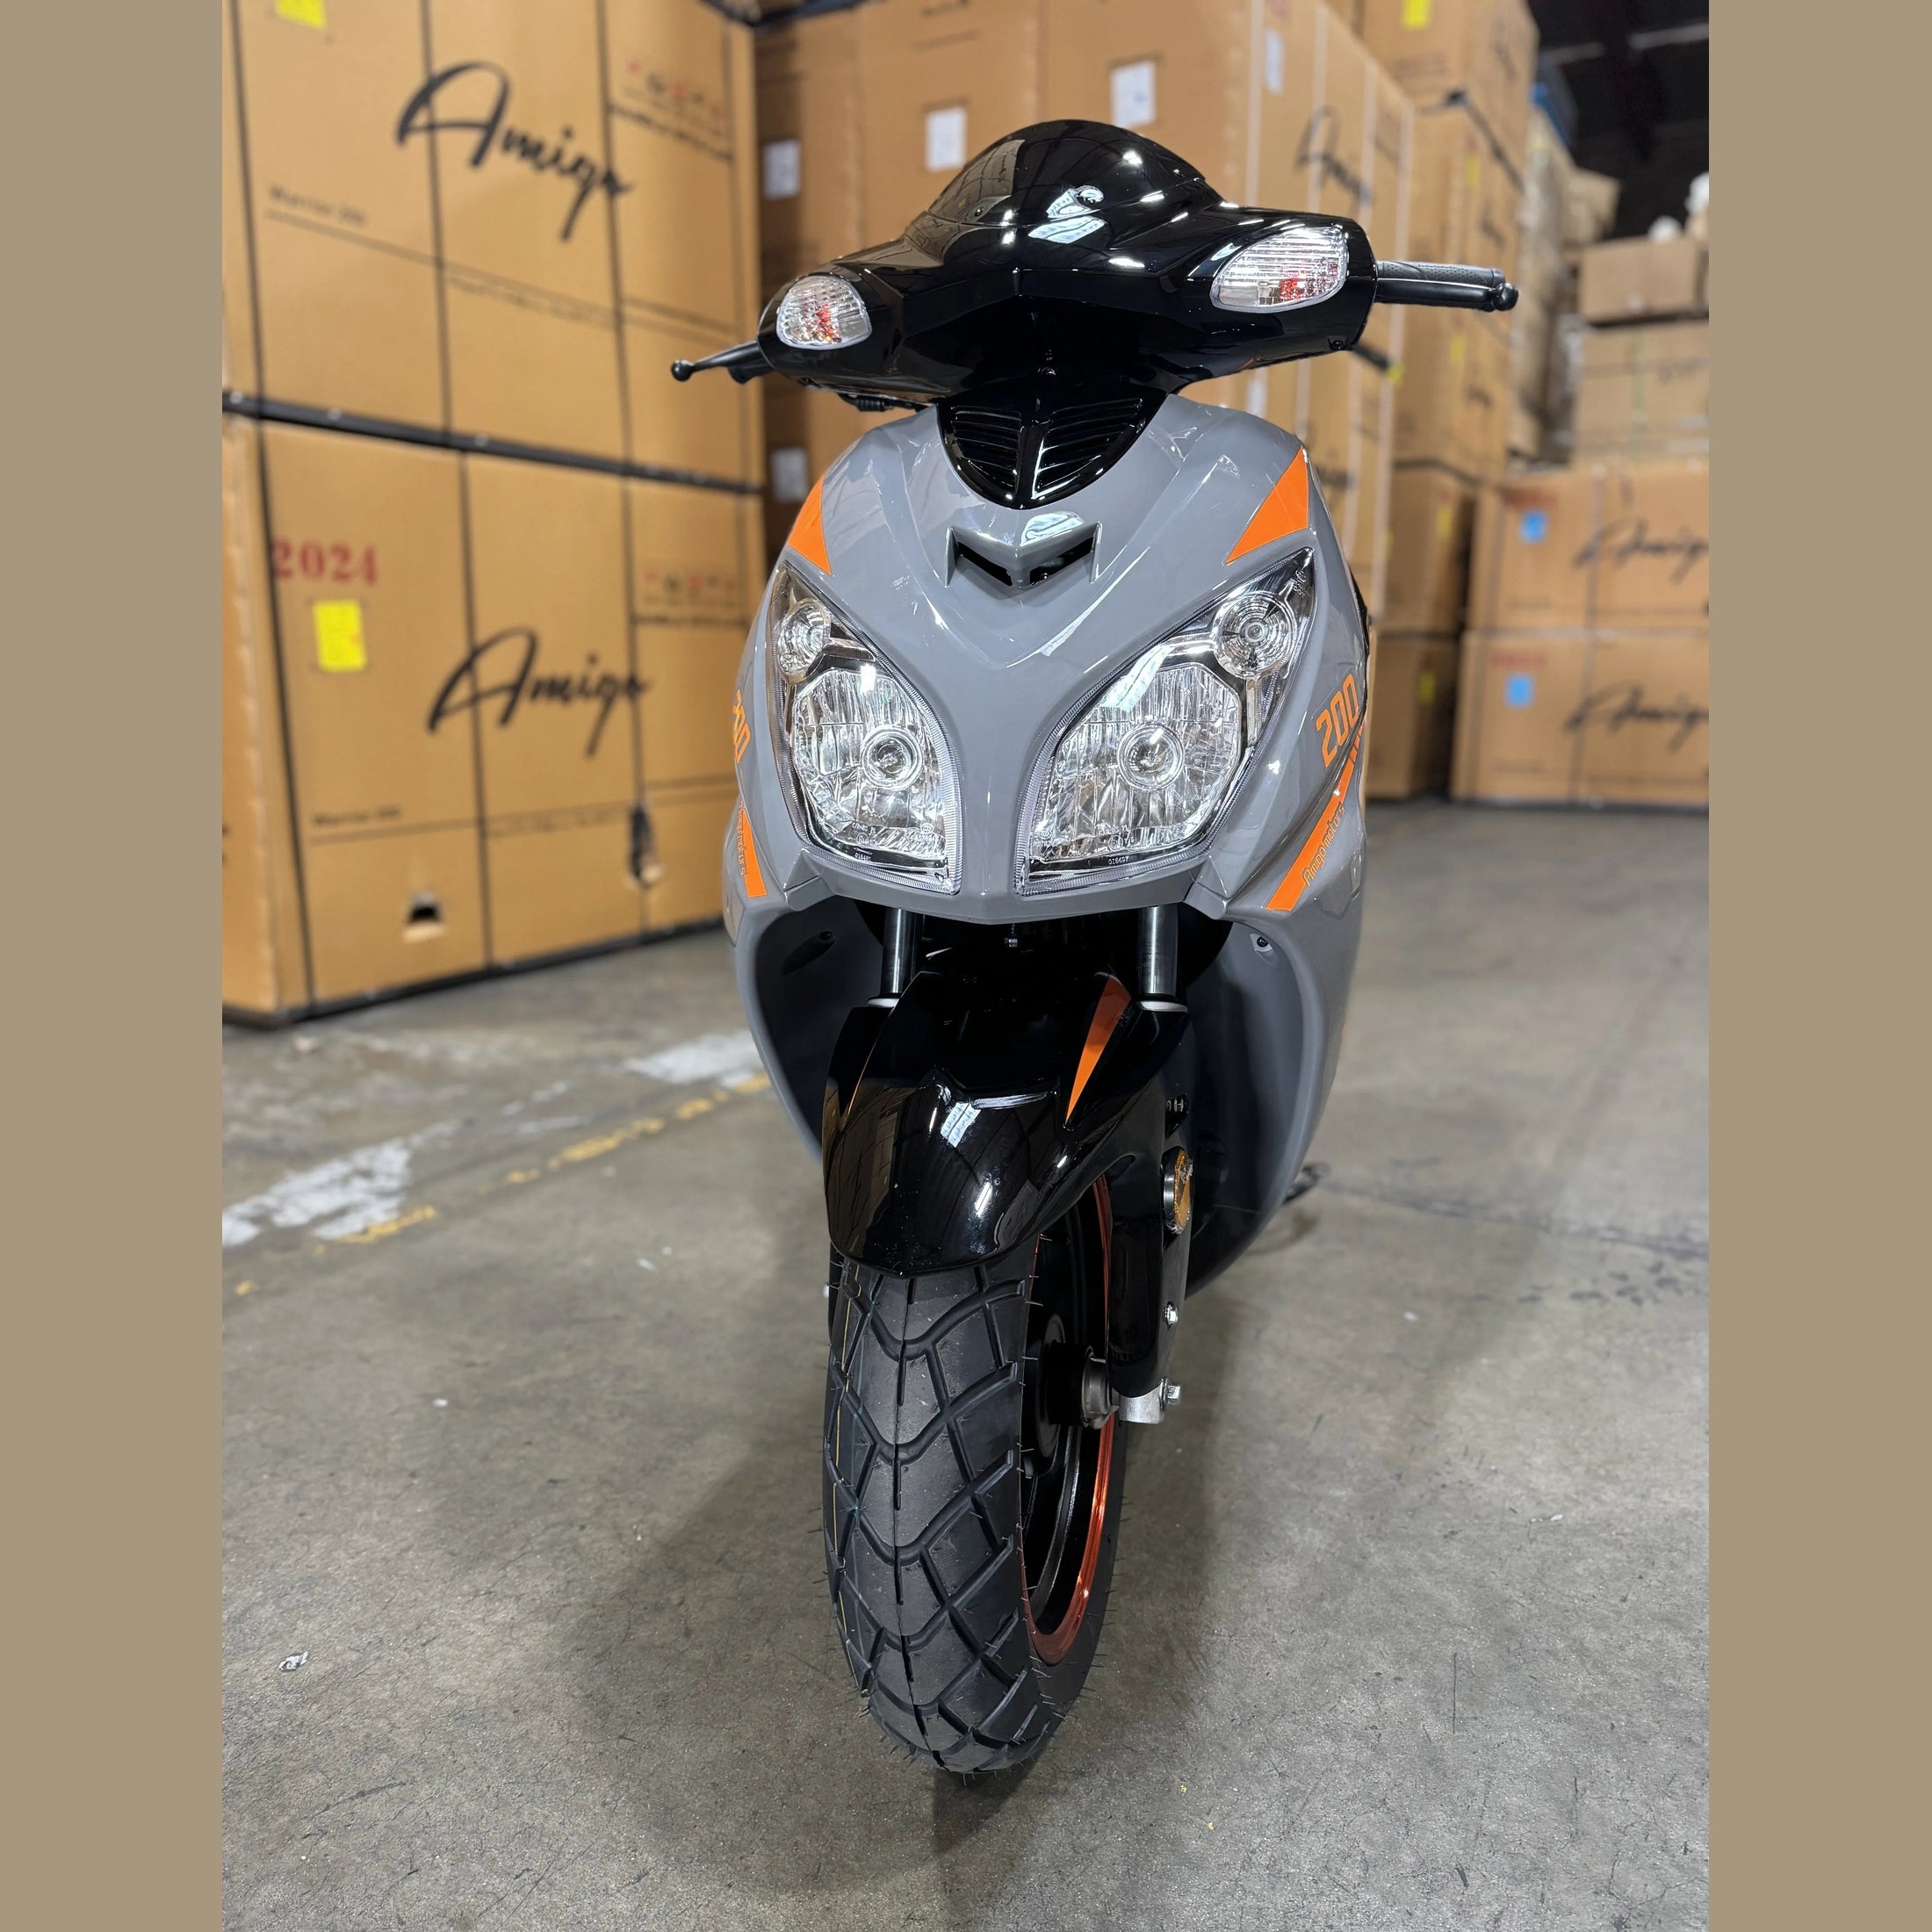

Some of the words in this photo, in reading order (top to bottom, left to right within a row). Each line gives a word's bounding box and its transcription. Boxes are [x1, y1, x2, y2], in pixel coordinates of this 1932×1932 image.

[395, 61, 635, 243] Amigo
[270, 538, 378, 586] 2024
[427, 626, 652, 760] Amigo
[1316, 674, 1359, 768] 200
[1302, 845, 1327, 887] Amigo
[1322, 804, 1345, 848] motors
